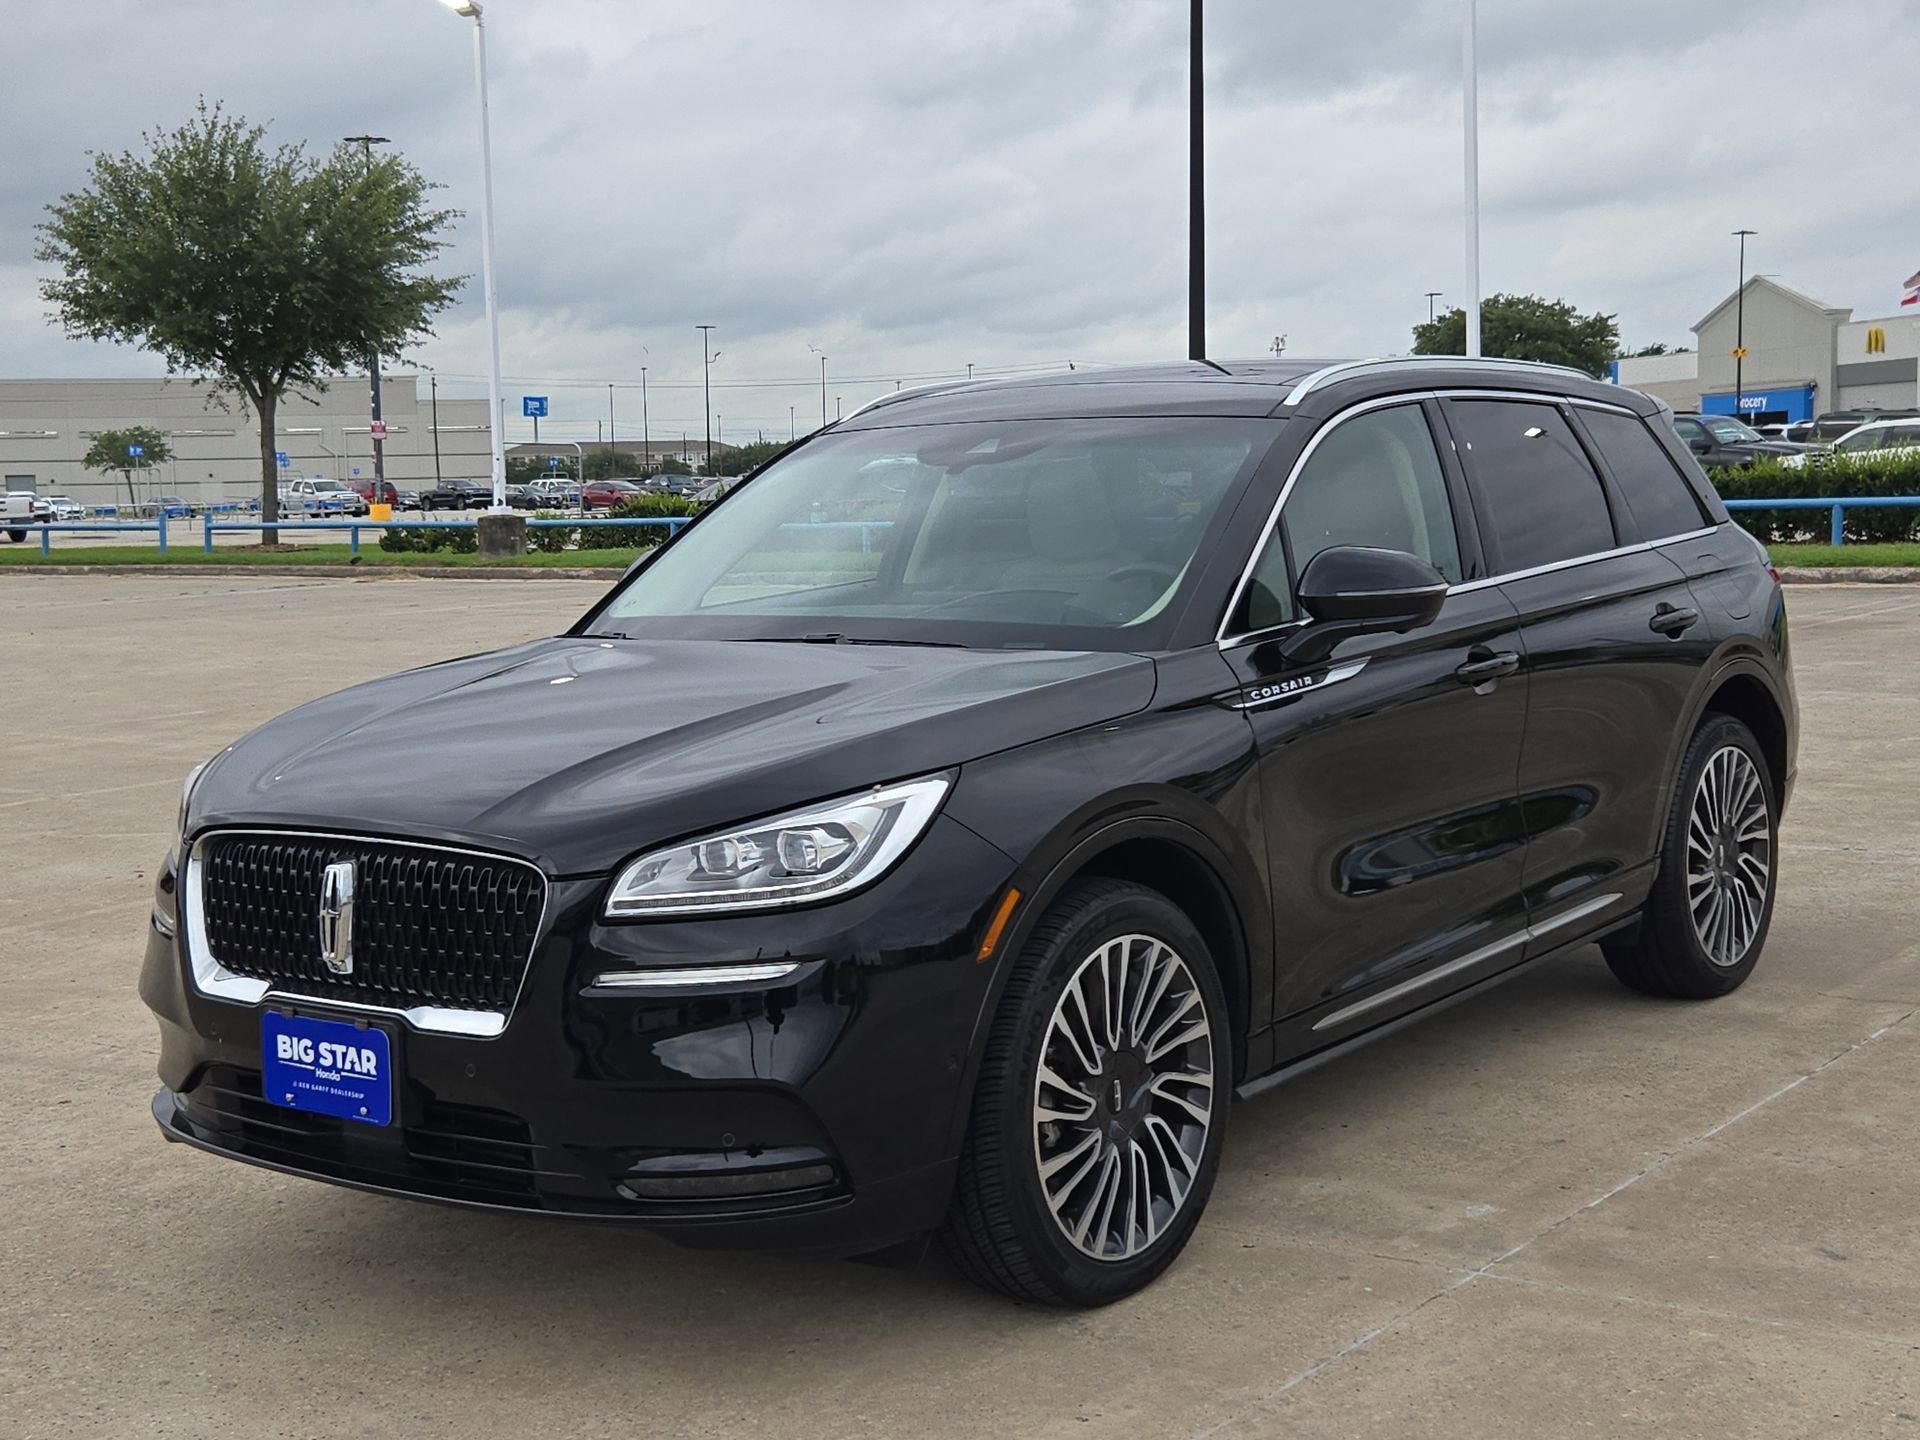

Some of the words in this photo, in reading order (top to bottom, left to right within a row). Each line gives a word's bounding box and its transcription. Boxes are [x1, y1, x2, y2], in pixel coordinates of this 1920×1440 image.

[1250, 676, 1313, 700] CORSAIR
[276, 1034, 315, 1063] BIG
[318, 1041, 377, 1075] STAR
[315, 1068, 341, 1081] Honda
